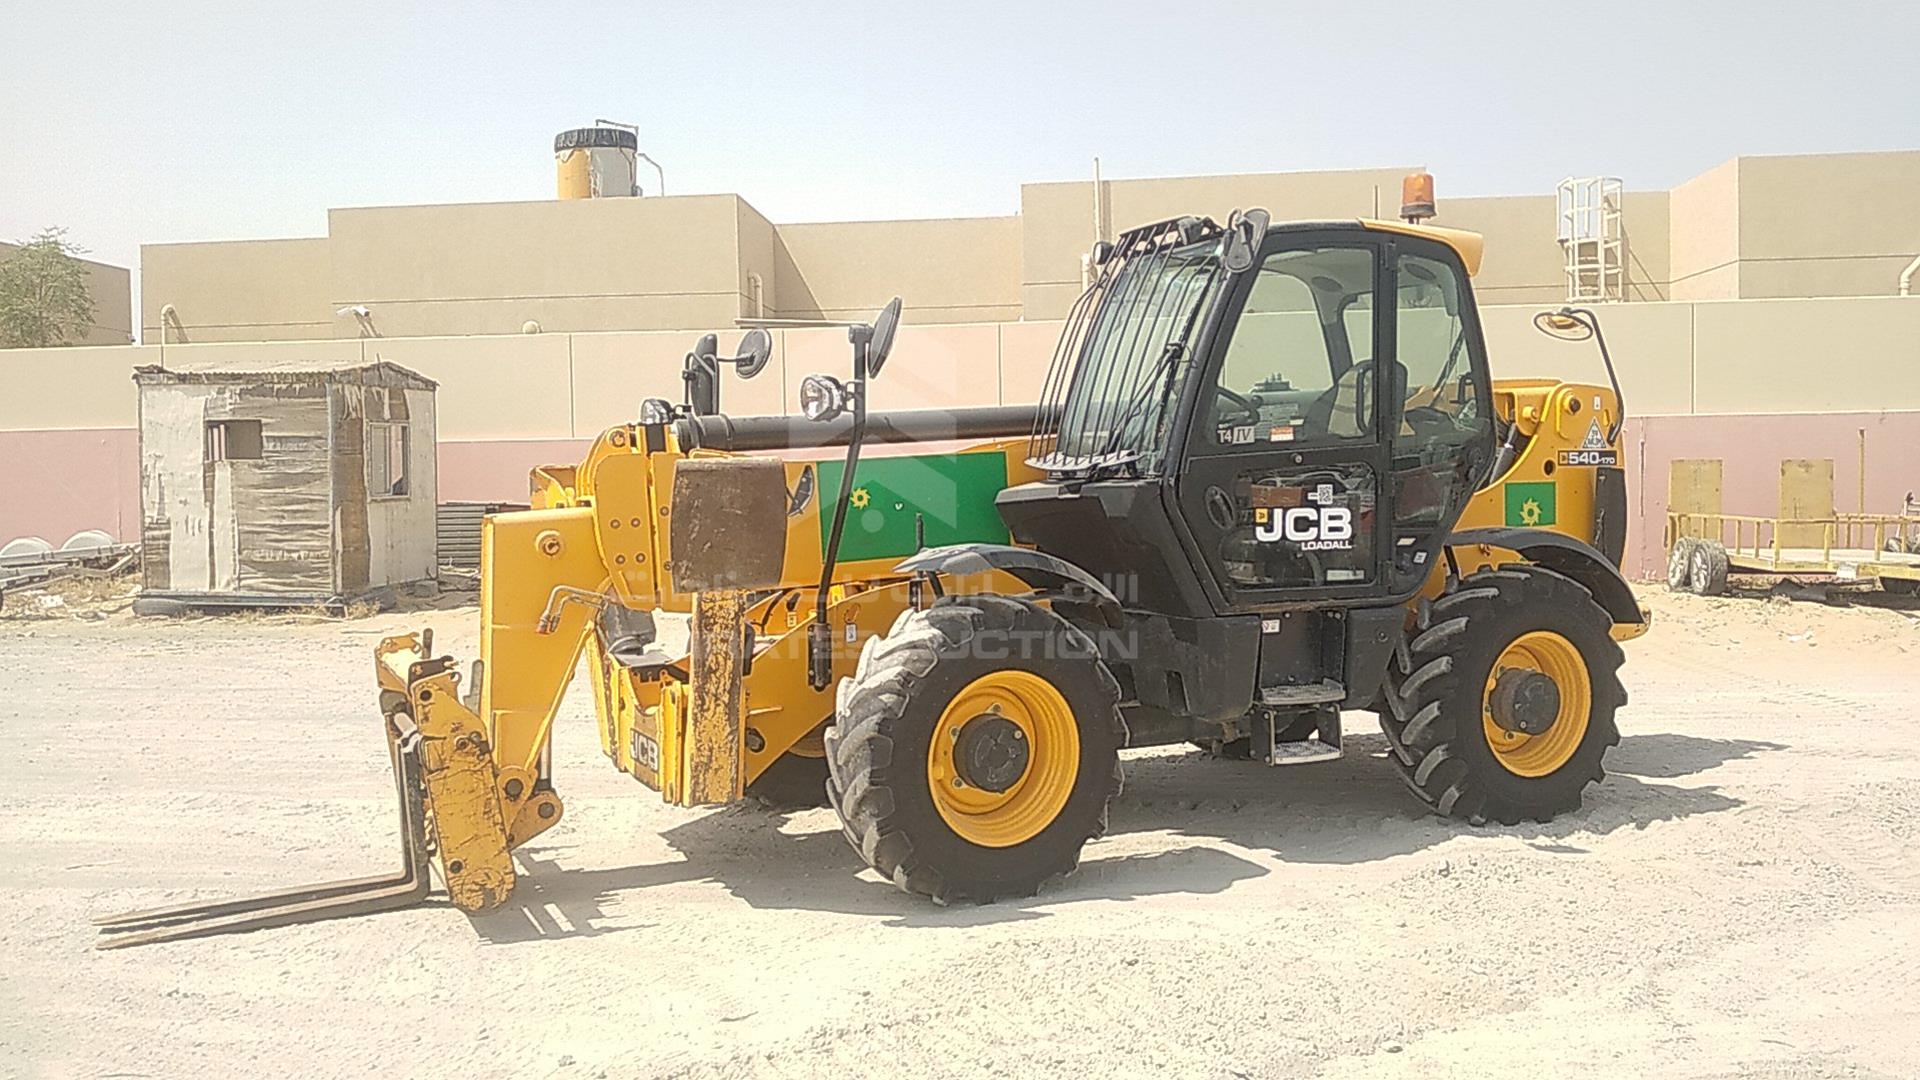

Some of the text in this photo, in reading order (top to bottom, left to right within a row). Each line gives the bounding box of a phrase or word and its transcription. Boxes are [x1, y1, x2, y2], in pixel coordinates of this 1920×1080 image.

[1255, 507, 1352, 542] JCB
[1301, 540, 1352, 551] LOADALL
[630, 729, 659, 773] JCB
